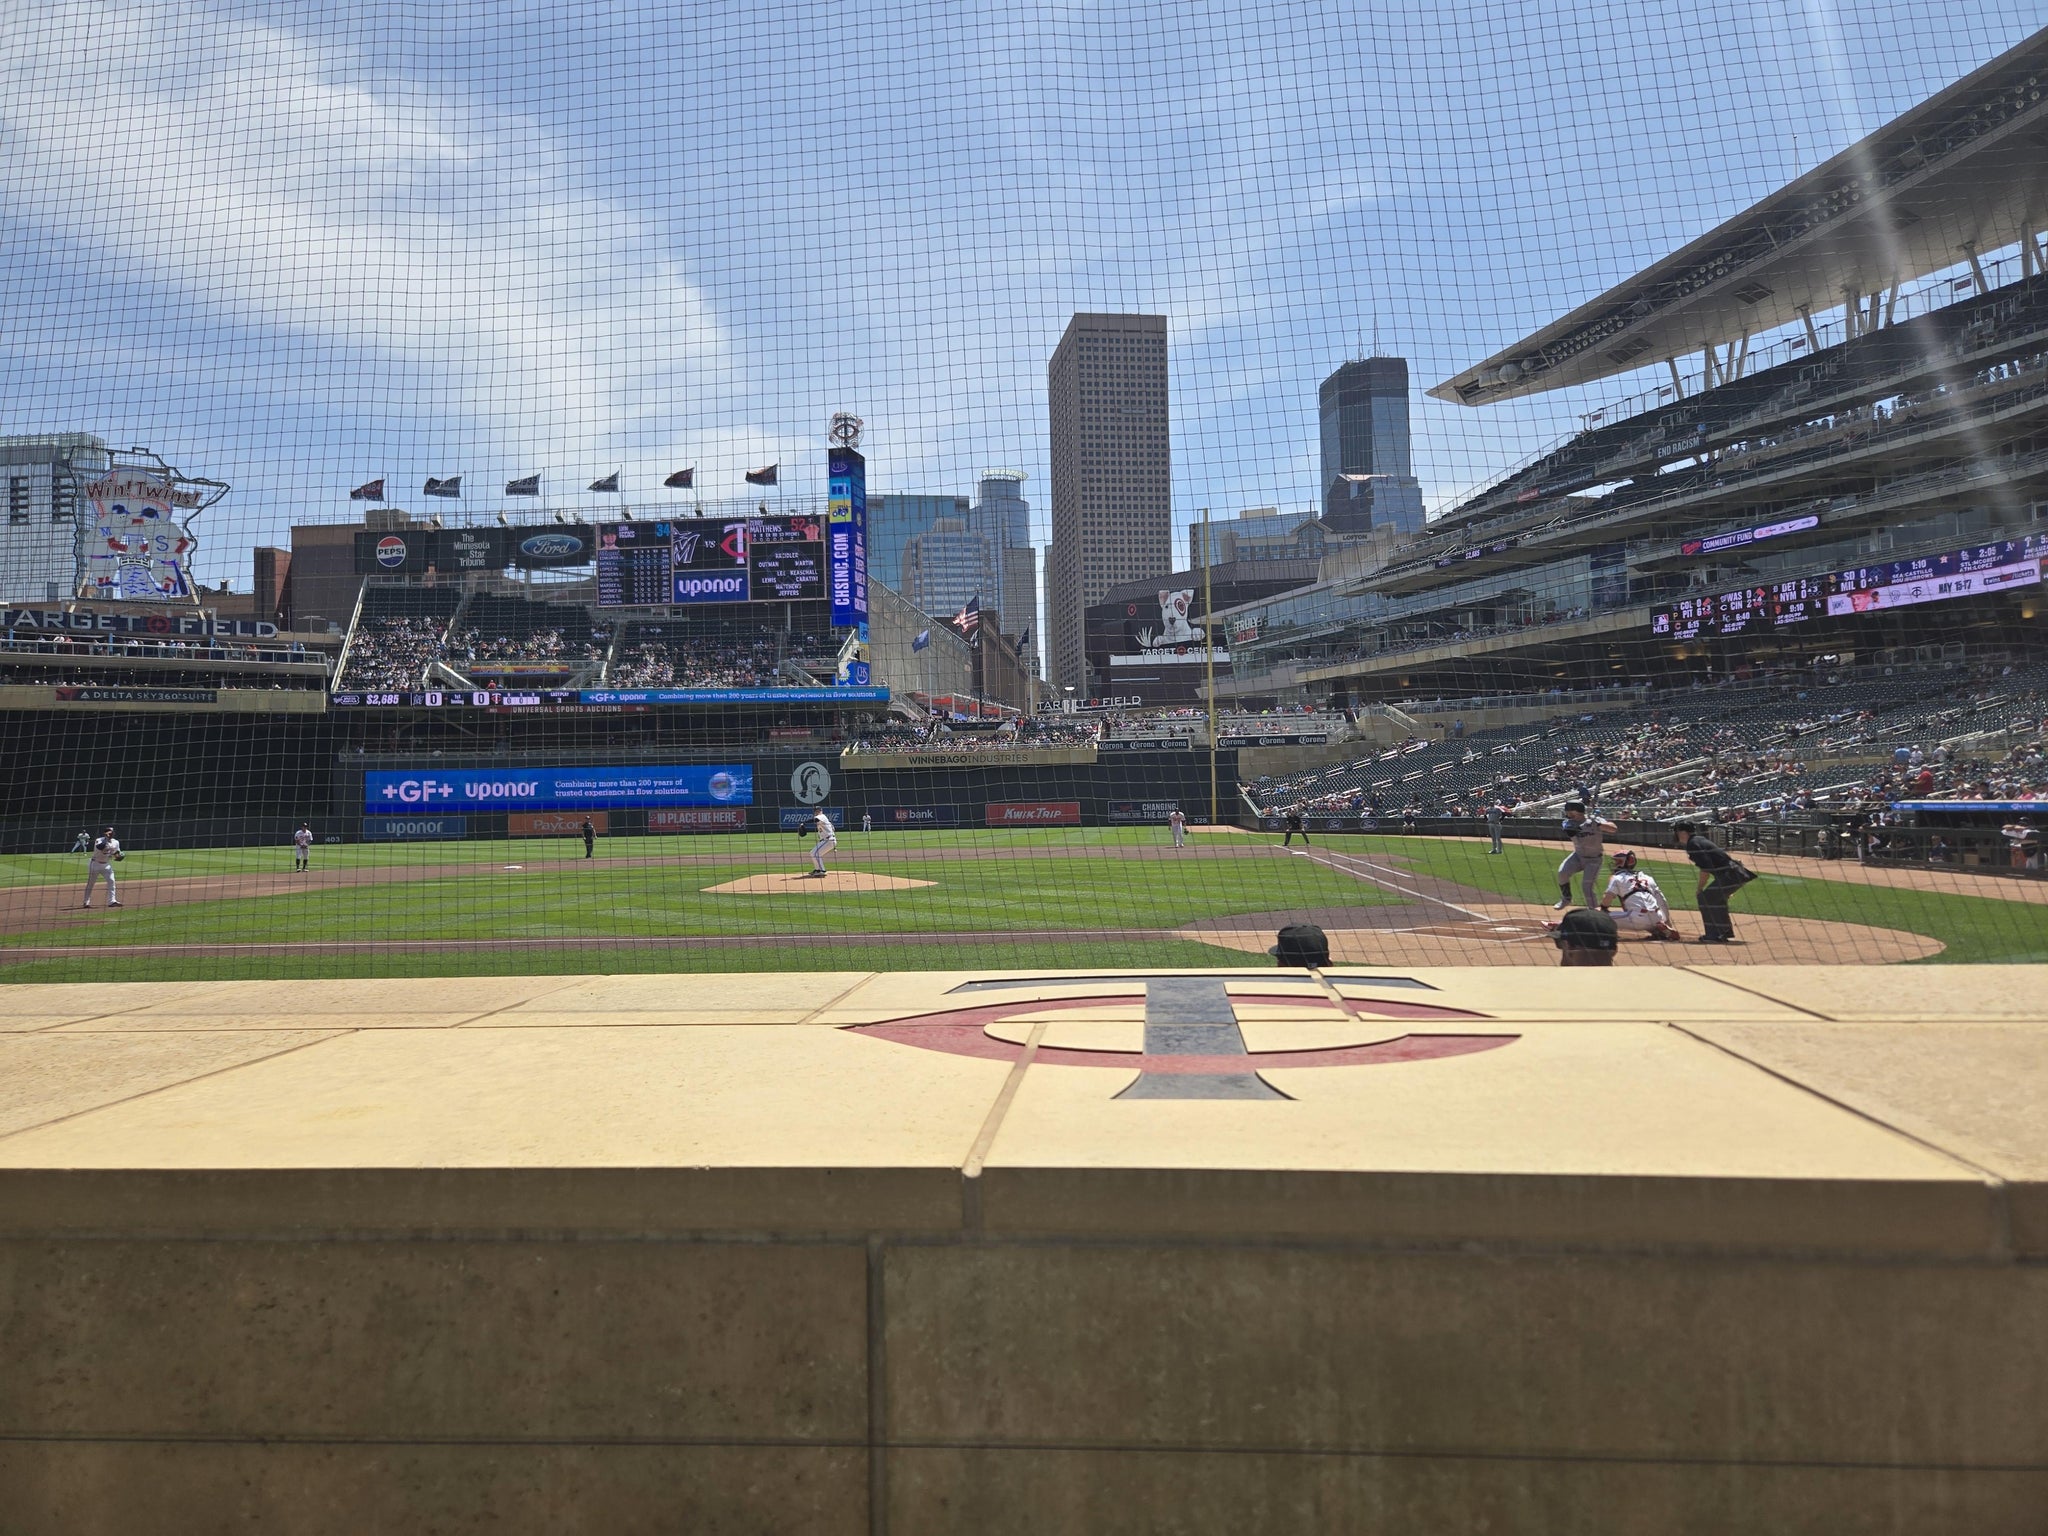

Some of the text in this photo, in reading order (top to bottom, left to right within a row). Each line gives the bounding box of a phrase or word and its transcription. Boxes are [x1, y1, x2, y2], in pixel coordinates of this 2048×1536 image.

[1657, 436, 1700, 458] END RACISM
[86, 478, 202, 505] Win! Twins!
[656, 523, 671, 538] 34
[462, 534, 474, 542] The
[1702, 534, 1736, 550] COMMUNITY
[1736, 531, 1752, 542] FUND
[156, 535, 169, 552] S
[453, 541, 490, 550] Minnesota
[532, 540, 571, 554] Ford
[470, 550, 486, 558] Star
[1979, 546, 1996, 558] 2:05
[459, 558, 486, 566] Tribune
[1911, 560, 1927, 570] 1:10
[834, 533, 850, 606] CHSINC.COM
[678, 578, 743, 598] uponor
[1782, 582, 1796, 592] DET
[1800, 580, 1806, 589] 3
[1840, 581, 1856, 592] MIL
[1860, 579, 1867, 588] 0
[1939, 582, 1952, 594] MAY
[1746, 590, 1752, 598] 0
[1780, 591, 1796, 602] NYM
[1801, 589, 1807, 599] 0
[1680, 601, 1693, 610] COL
[1696, 599, 1702, 607] 0
[1730, 600, 1743, 610] CIN
[1747, 599, 1752, 608] 2
[1682, 609, 1693, 619] PIT
[1735, 612, 1750, 621] 6:40
[0, 608, 278, 638] TARGET FIELD
[1653, 624, 1669, 634] MLB
[1142, 648, 1176, 656] TARGET
[93, 691, 133, 699] DELTA
[366, 694, 400, 705] $2,685
[619, 694, 648, 702] uponor
[1103, 696, 1142, 706] FIELD
[1161, 740, 1187, 748] Corona
[1220, 738, 1246, 747] Corona
[1259, 737, 1286, 746] Corona
[1299, 736, 1326, 744] Corona
[1099, 742, 1124, 750] Corona
[1130, 741, 1155, 750] Corona
[908, 754, 1029, 764] WINNEBAGO INDUSTRIES
[555, 780, 597, 789] Combining
[465, 782, 539, 800] uponor
[1142, 803, 1177, 811] CHANGING
[667, 812, 697, 824] PLACE
[712, 812, 737, 823] HERE
[386, 822, 444, 836] uponor
[533, 818, 582, 833] Paycor
